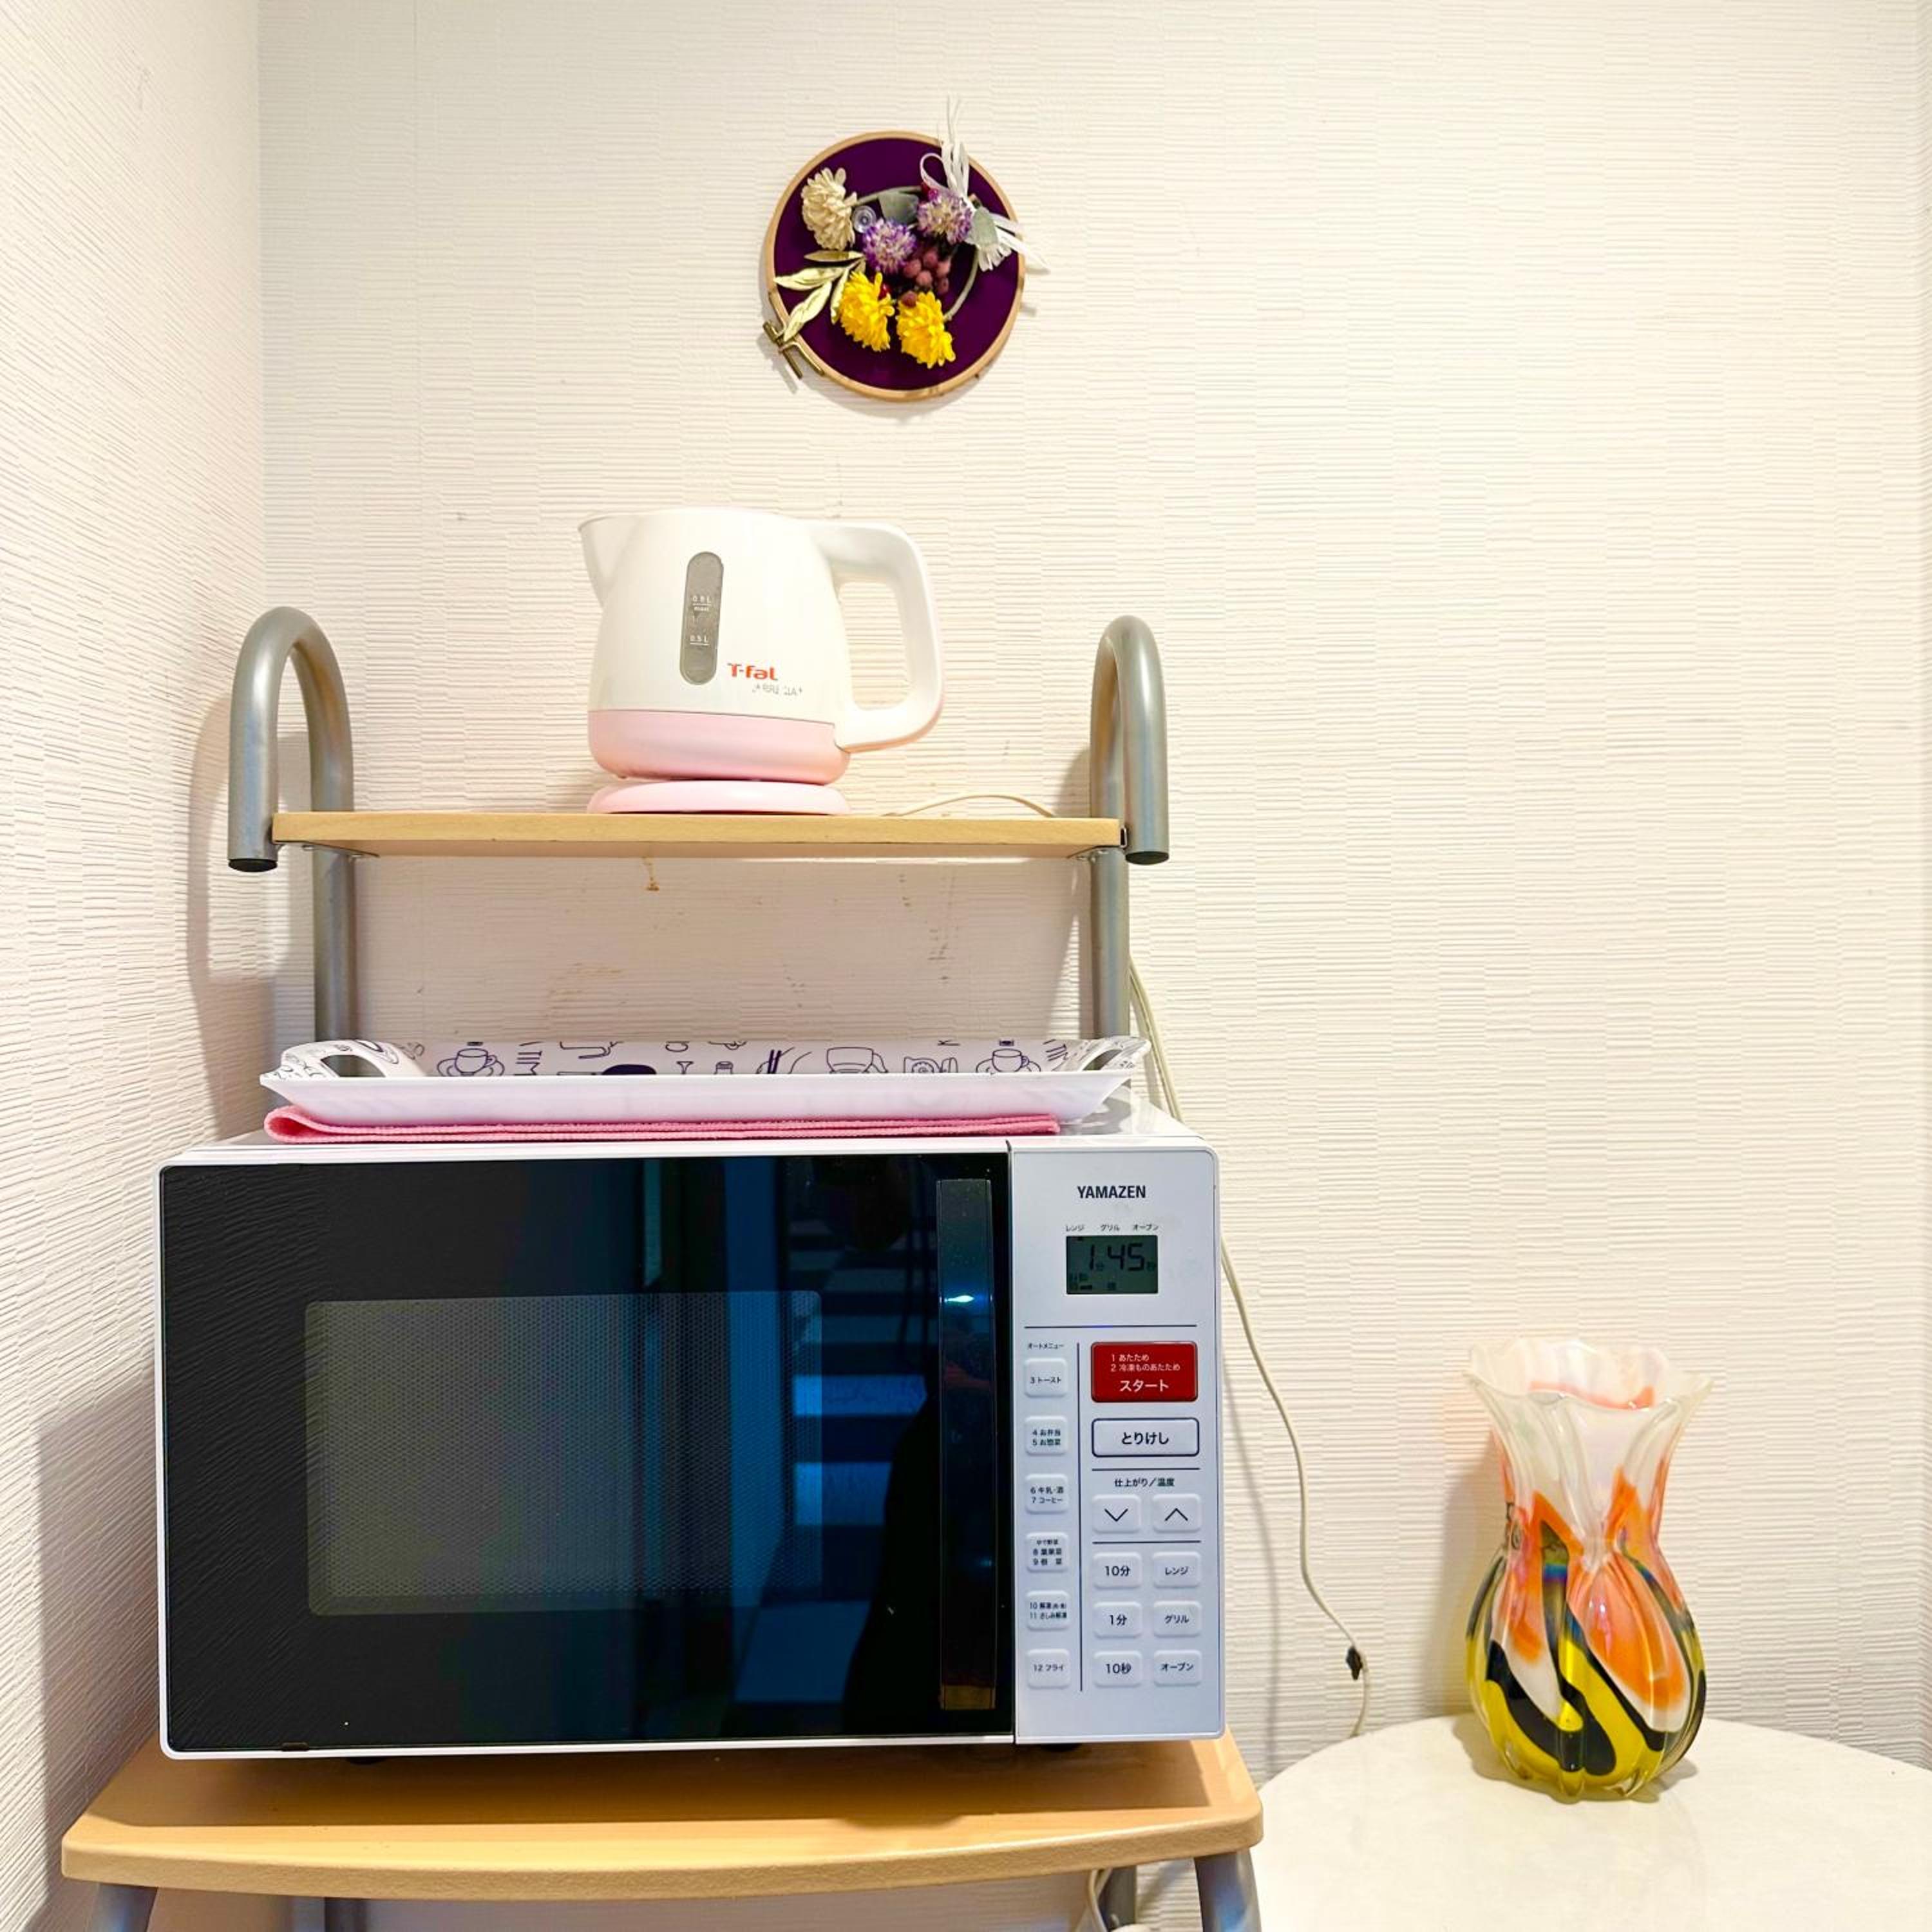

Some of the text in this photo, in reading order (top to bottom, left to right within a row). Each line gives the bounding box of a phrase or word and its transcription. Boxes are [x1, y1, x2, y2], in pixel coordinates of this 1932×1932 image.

[726, 663, 779, 681] T-fal
[1077, 1185, 1146, 1198] YAMAZEN
[1119, 1354, 1150, 1362] あたため
[1111, 1364, 1117, 1372] 2
[1119, 1379, 1170, 1393] スタート
[1121, 1432, 1170, 1445] とりけし
[1104, 1566, 1189, 1577] 10分 レンジ
[1110, 1615, 1189, 1626] 1分 グリル
[1105, 1663, 1193, 1675] 10秒 オープン
